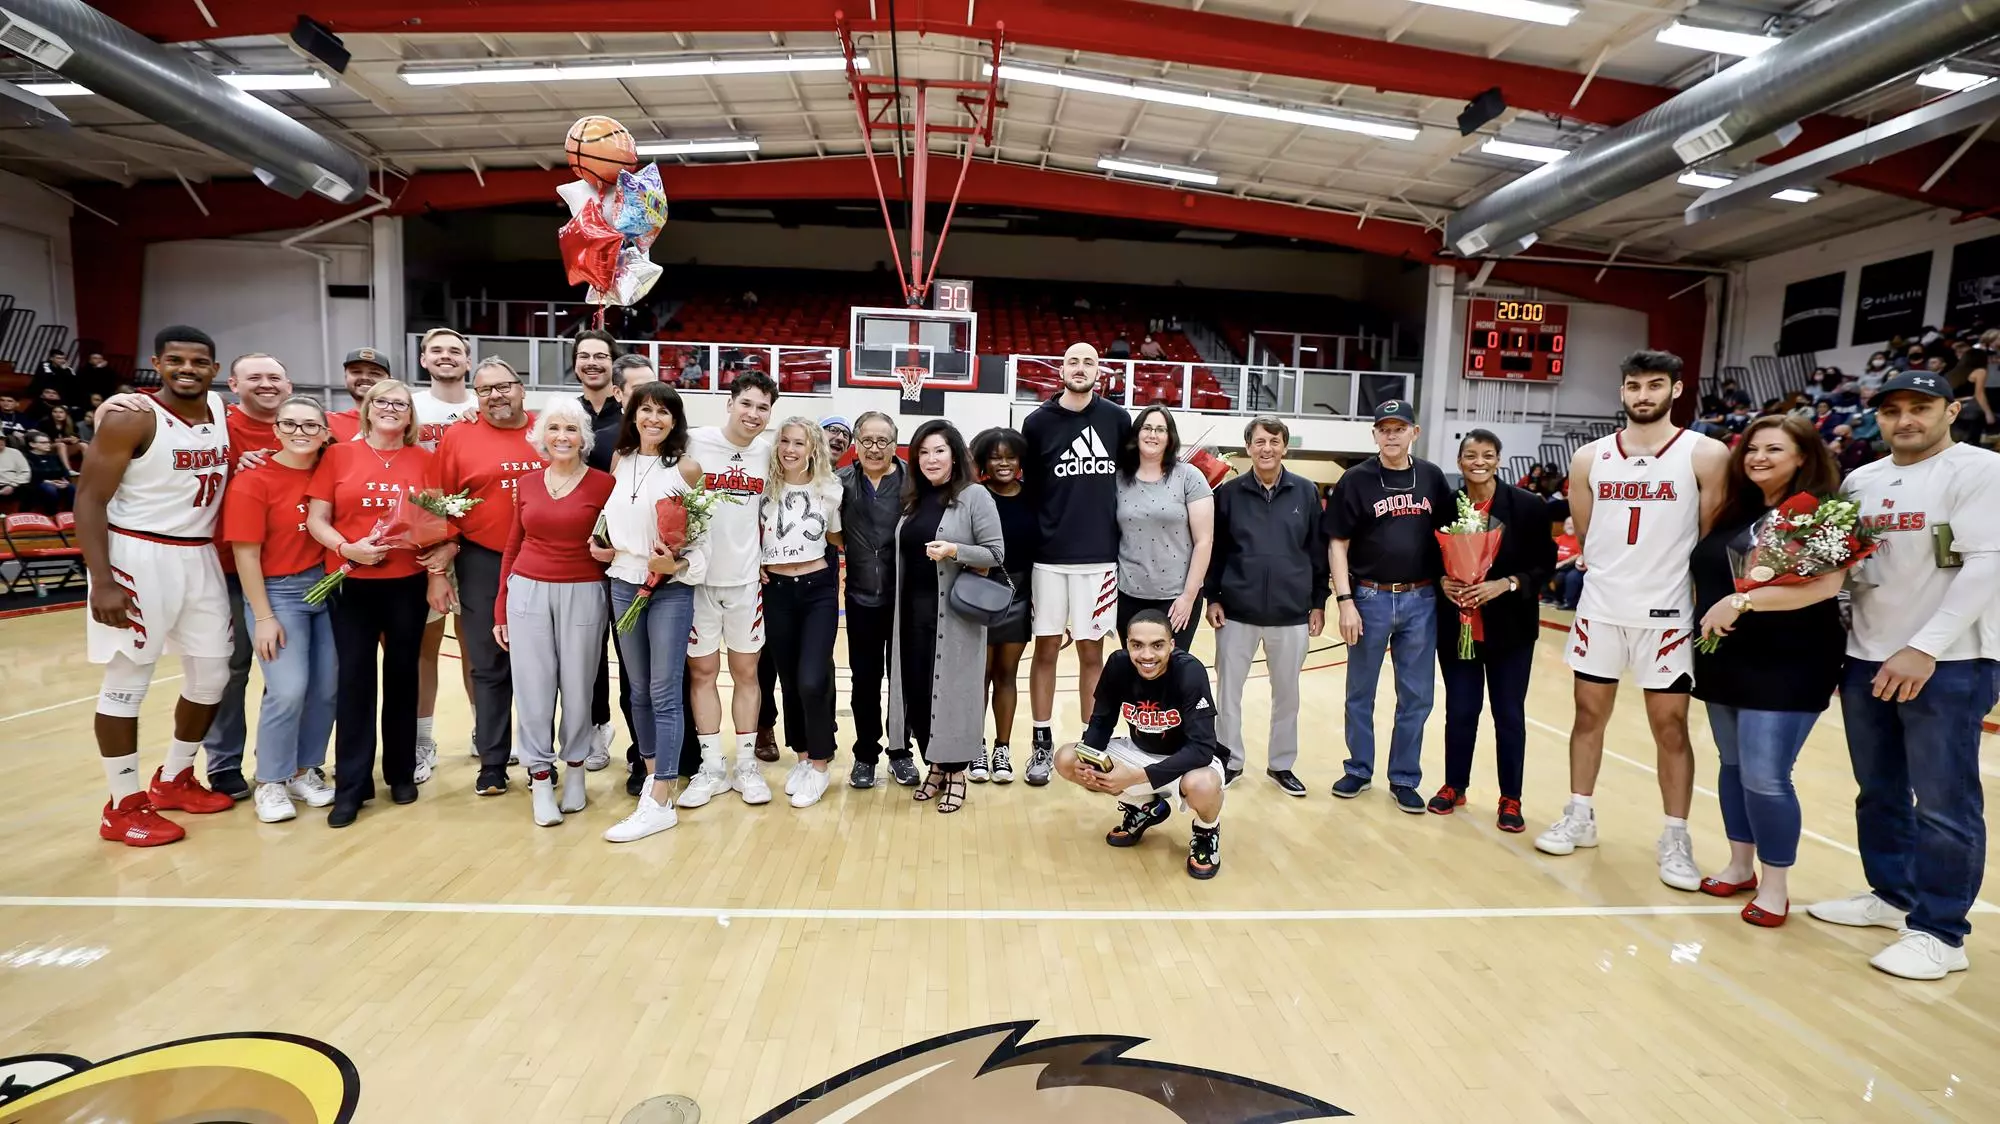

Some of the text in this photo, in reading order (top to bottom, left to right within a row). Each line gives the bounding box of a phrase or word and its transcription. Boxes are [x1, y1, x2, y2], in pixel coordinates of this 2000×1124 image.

[940, 285, 968, 311] 30
[1498, 302, 1543, 321] 20:00
[1487, 331, 1498, 348] 0
[1517, 335, 1523, 347] 1
[1552, 335, 1563, 352] 0
[1474, 355, 1484, 369] 0
[1552, 359, 1561, 373] 0
[501, 461, 542, 471] TEAM
[1054, 457, 1116, 477] adidas
[703, 473, 765, 494] EAGLES
[1598, 481, 1677, 500] BIOLA
[1373, 494, 1432, 518] BIOLA
[1392, 508, 1421, 517] EAGLES
[1627, 507, 1641, 545] 1
[1120, 702, 1182, 727] EAGLES
